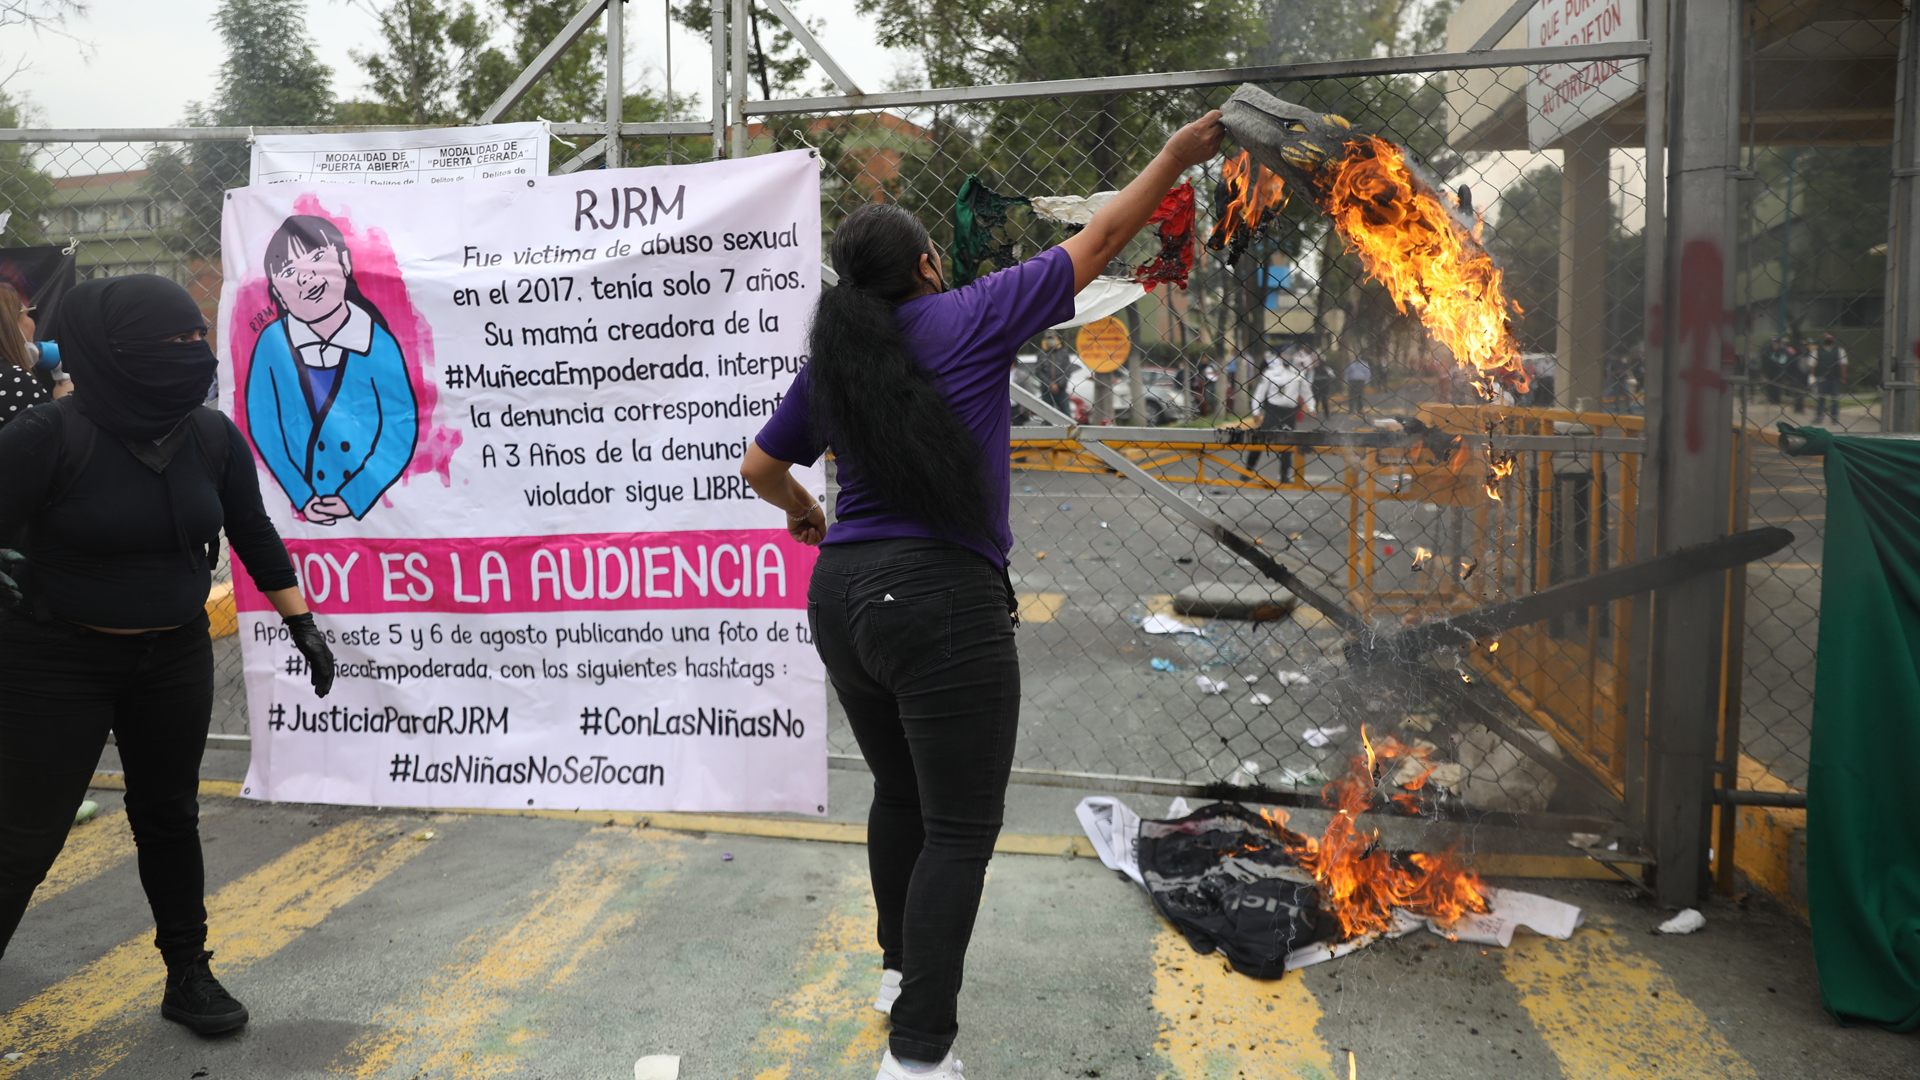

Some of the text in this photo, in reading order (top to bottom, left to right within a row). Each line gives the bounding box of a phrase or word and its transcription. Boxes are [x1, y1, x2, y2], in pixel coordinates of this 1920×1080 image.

[1541, 10, 1560, 46] QUE
[316, 160, 415, 172] “PUERTA ABIERTA”
[325, 151, 407, 163] MODALIDAD DE
[427, 148, 529, 168] “PUERTA CERRADA”
[440, 140, 518, 158] MODALIDAD DE
[431, 176, 454, 184] Delitos
[482, 166, 526, 179] Delitos de
[574, 184, 686, 232] RJRM
[462, 222, 800, 268] Fue victima de abuso sexual
[452, 267, 806, 308] en el 2017, tenía solo 7 años.
[248, 305, 276, 335] RJRM
[484, 307, 780, 348] Su mamá creadora de la
[445, 352, 811, 389] #MuñecaEmpoderada, interpus
[469, 393, 784, 429] la denuncia correspondient
[481, 436, 753, 469] A 3 Años de la denunci
[523, 480, 616, 508] violador
[625, 479, 685, 512] sigue
[379, 551, 434, 602] ES
[450, 549, 511, 602] LA
[531, 543, 786, 602] AUDIENCIA
[340, 625, 381, 647] este
[388, 623, 403, 645] 5
[410, 628, 424, 652] y
[429, 622, 444, 645] 6
[450, 623, 473, 645] de
[479, 623, 548, 653] agosto
[555, 620, 664, 649] publicando
[671, 625, 711, 644] una
[717, 619, 759, 646] foto
[766, 620, 790, 643] de
[794, 620, 813, 646] tu
[499, 663, 536, 680] con
[541, 657, 569, 680] los
[576, 656, 678, 687] siguientes
[684, 655, 776, 687] hashtags
[267, 702, 806, 740] #JusticiaParaRJRM #ConLasNiñasNo
[388, 752, 665, 787] #LasNiñasNoSeTocan
